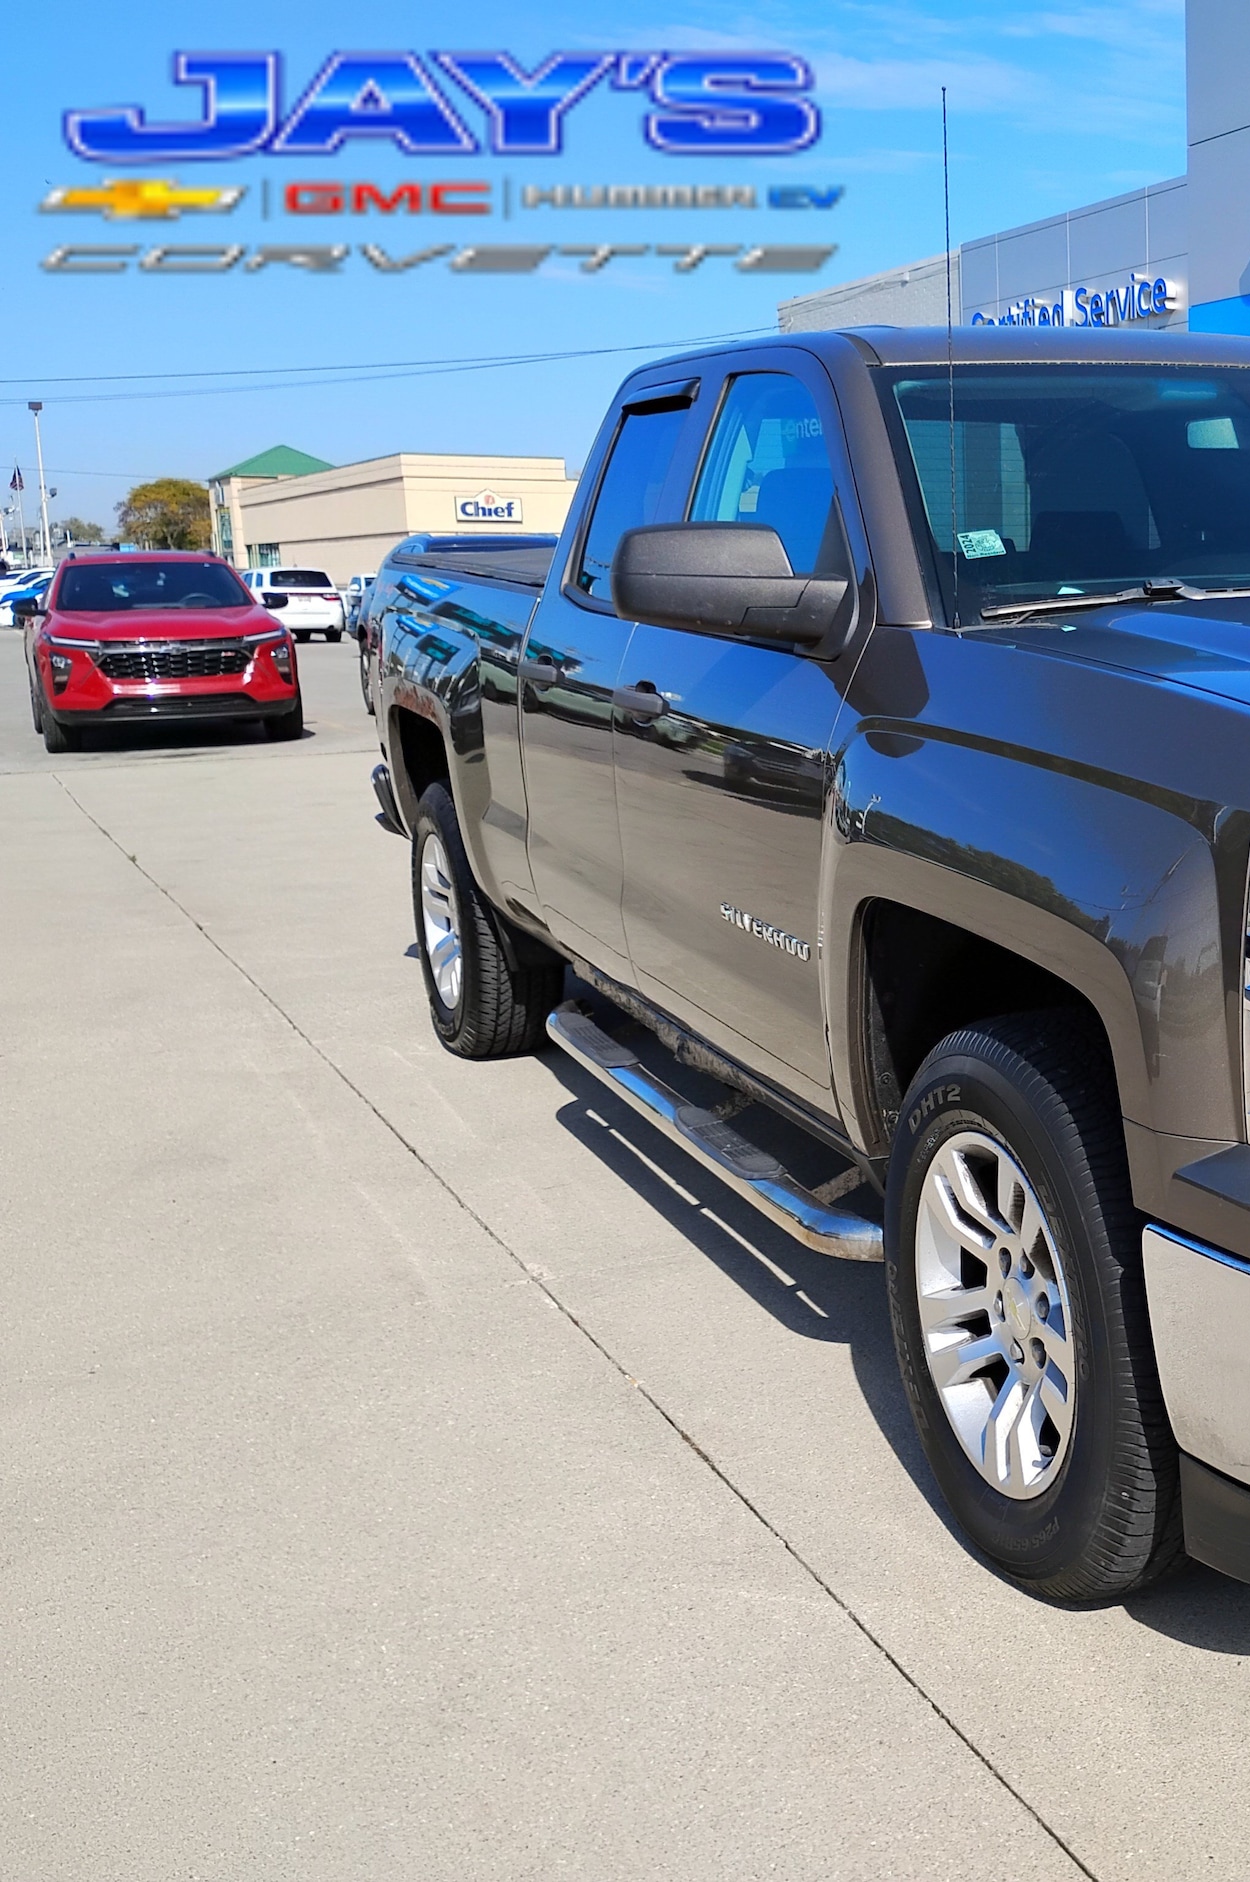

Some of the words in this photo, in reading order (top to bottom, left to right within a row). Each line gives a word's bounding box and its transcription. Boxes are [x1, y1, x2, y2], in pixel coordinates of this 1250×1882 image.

[1074, 272, 1172, 328] Service
[460, 501, 515, 518] Chief
[960, 534, 977, 554] 2024
[720, 901, 811, 962] SILVERADO
[907, 1083, 962, 1135] DHT2
